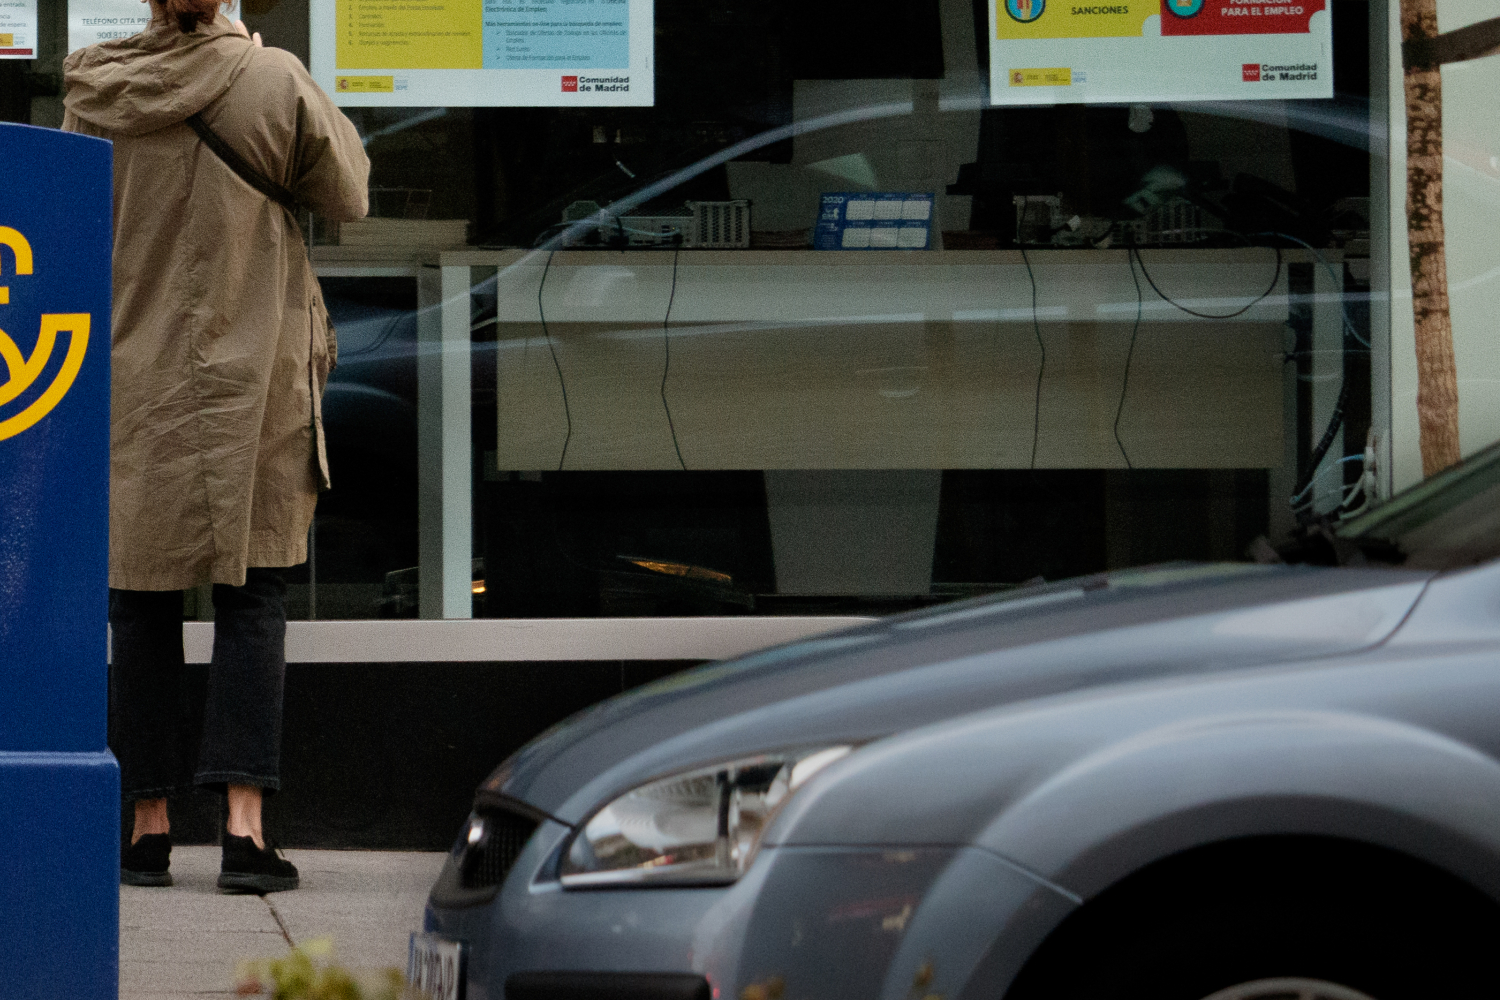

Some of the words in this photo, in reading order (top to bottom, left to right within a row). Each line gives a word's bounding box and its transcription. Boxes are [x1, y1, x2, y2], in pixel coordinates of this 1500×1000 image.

[1072, 6, 1129, 16] SANCIONES
[1221, 7, 1247, 17] PARA
[1251, 7, 1262, 17] EL
[1264, 6, 1304, 16] EMPLEO
[1262, 64, 1317, 72] Comunidad
[1262, 73, 1276, 82] de
[1279, 72, 1317, 81] Madrid
[595, 84, 629, 92] Madrid
